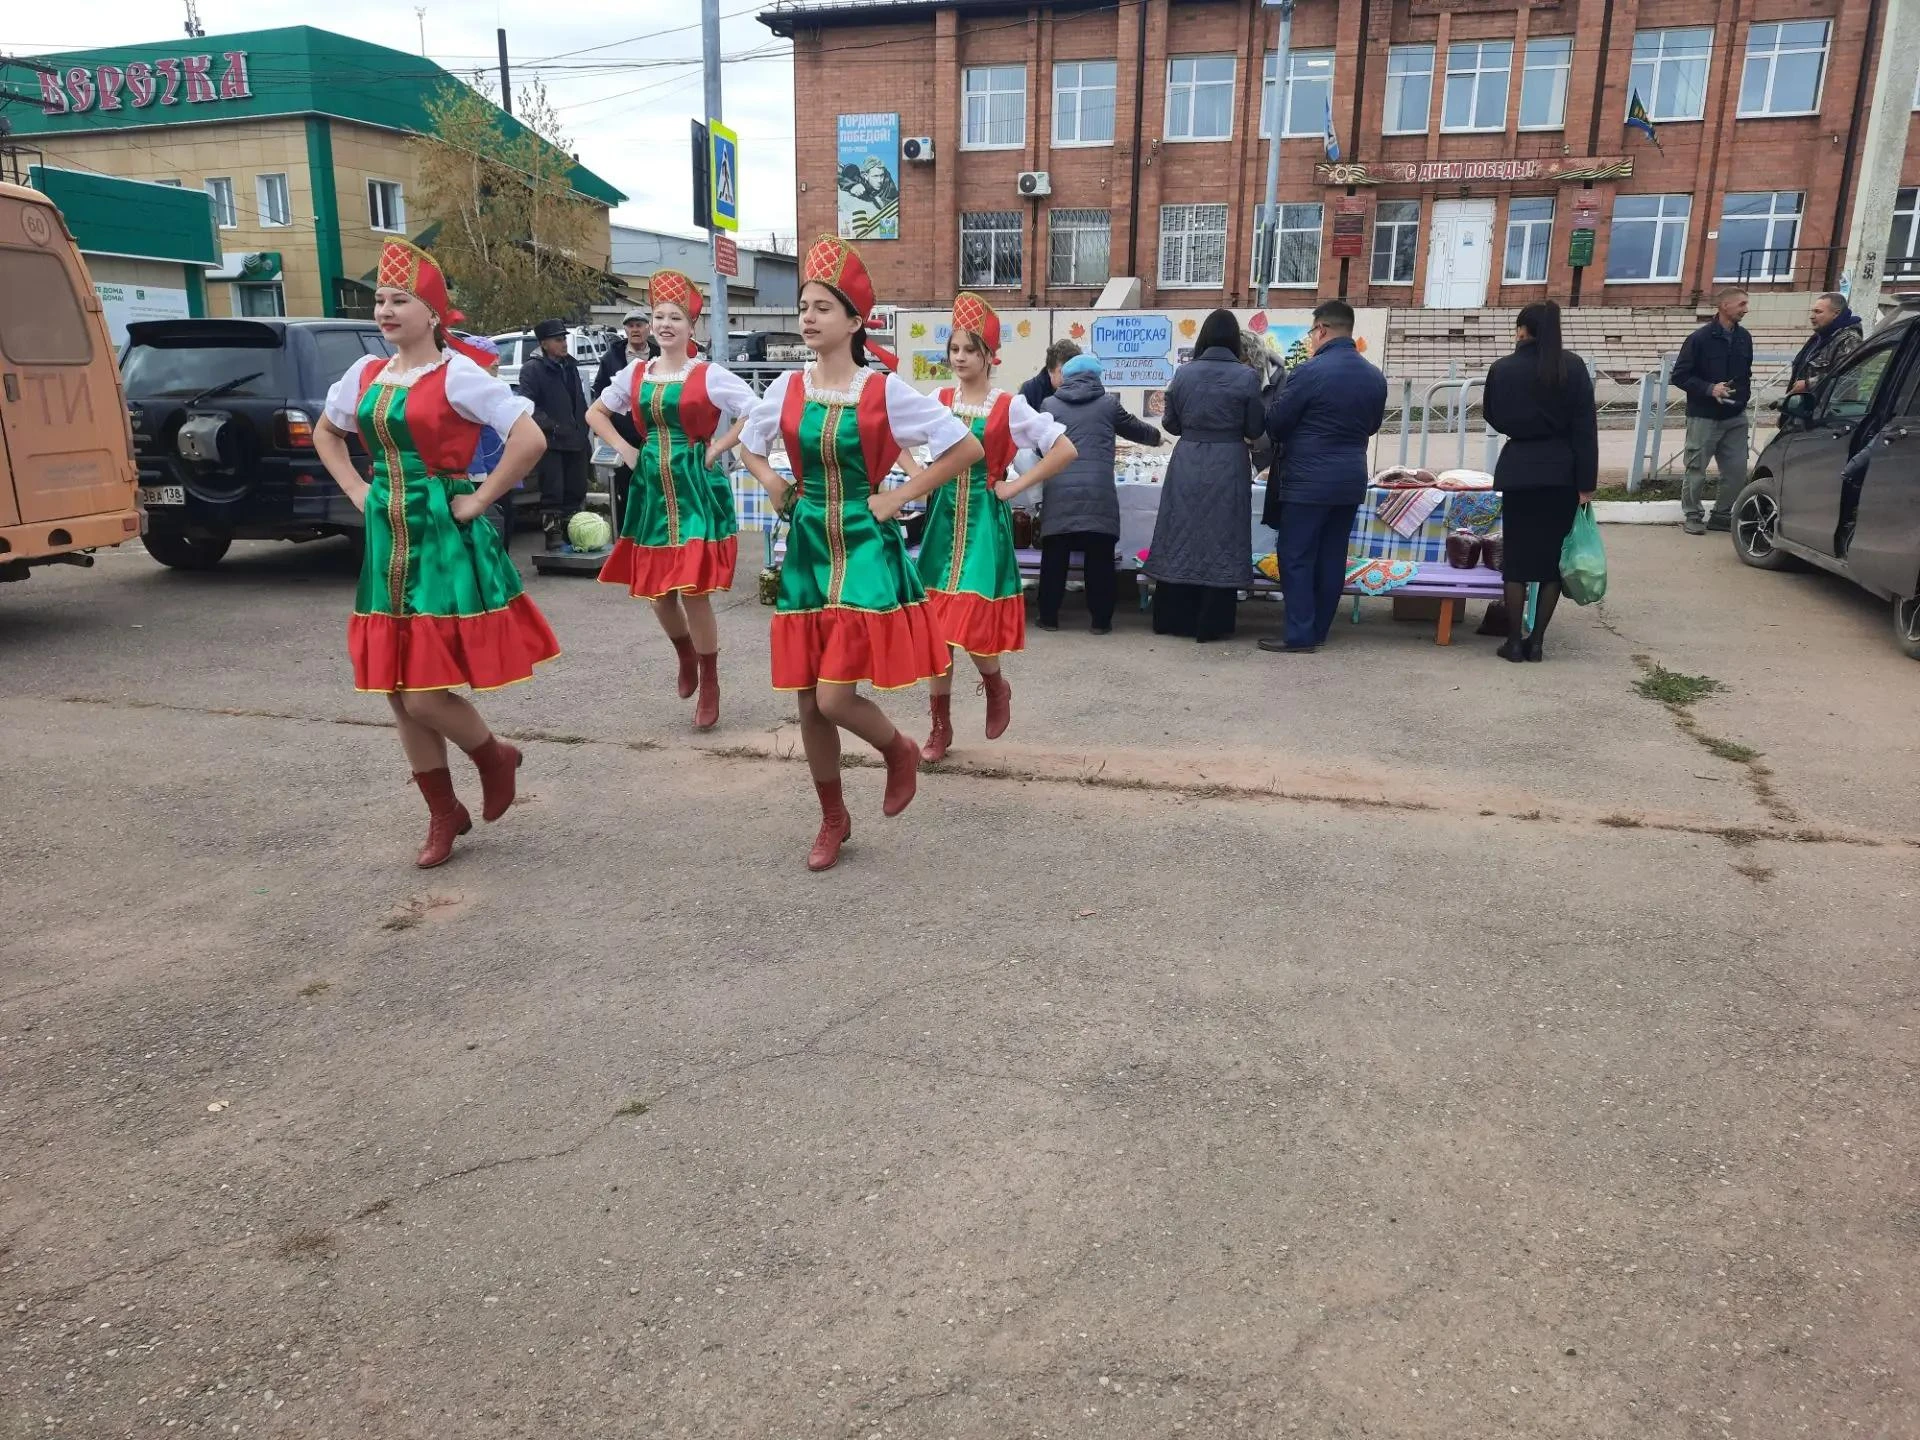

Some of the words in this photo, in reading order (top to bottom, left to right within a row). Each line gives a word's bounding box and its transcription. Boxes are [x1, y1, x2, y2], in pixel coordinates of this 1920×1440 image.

[839, 113, 896, 128] ГОРДИМСЯ
[840, 128, 891, 144] ПОБЕДОЙ!
[1406, 164, 1416, 179] С
[1418, 163, 1462, 181] ДНЕМ
[1465, 160, 1534, 179] ПОБЕДЫ!
[27, 217, 44, 234] 60
[23, 373, 94, 426] ТИ
[165, 488, 181, 499] 138
